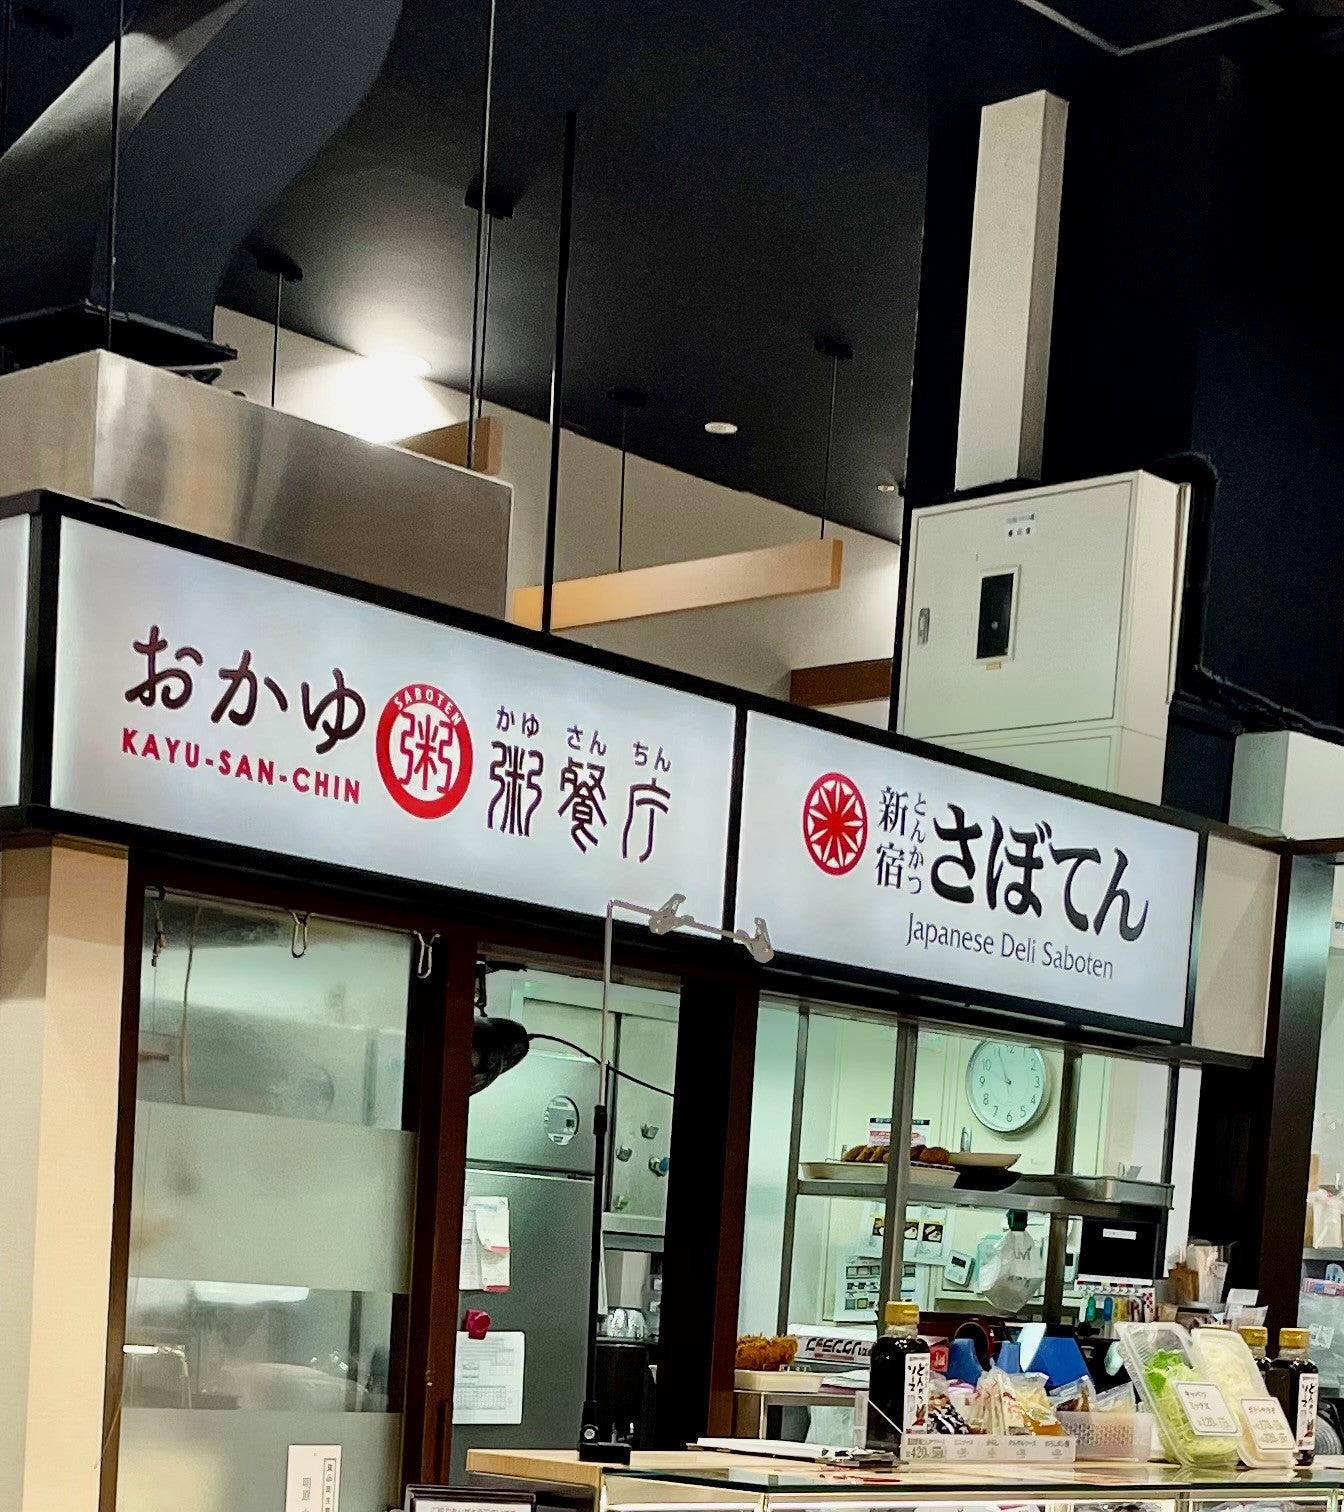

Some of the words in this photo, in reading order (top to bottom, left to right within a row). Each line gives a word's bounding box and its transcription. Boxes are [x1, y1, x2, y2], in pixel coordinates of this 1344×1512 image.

[124, 625, 366, 753] おかゆ
[394, 687, 465, 725] SABOTEN
[122, 727, 361, 804] KAYU-SAN-CHIN
[875, 786, 908, 889] 新宿
[907, 792, 926, 895] とんかつ
[930, 803, 1148, 941] さぼてん
[906, 913, 995, 956] Japanese
[1001, 932, 1036, 964] Deli
[1041, 941, 1113, 979] Saboten
